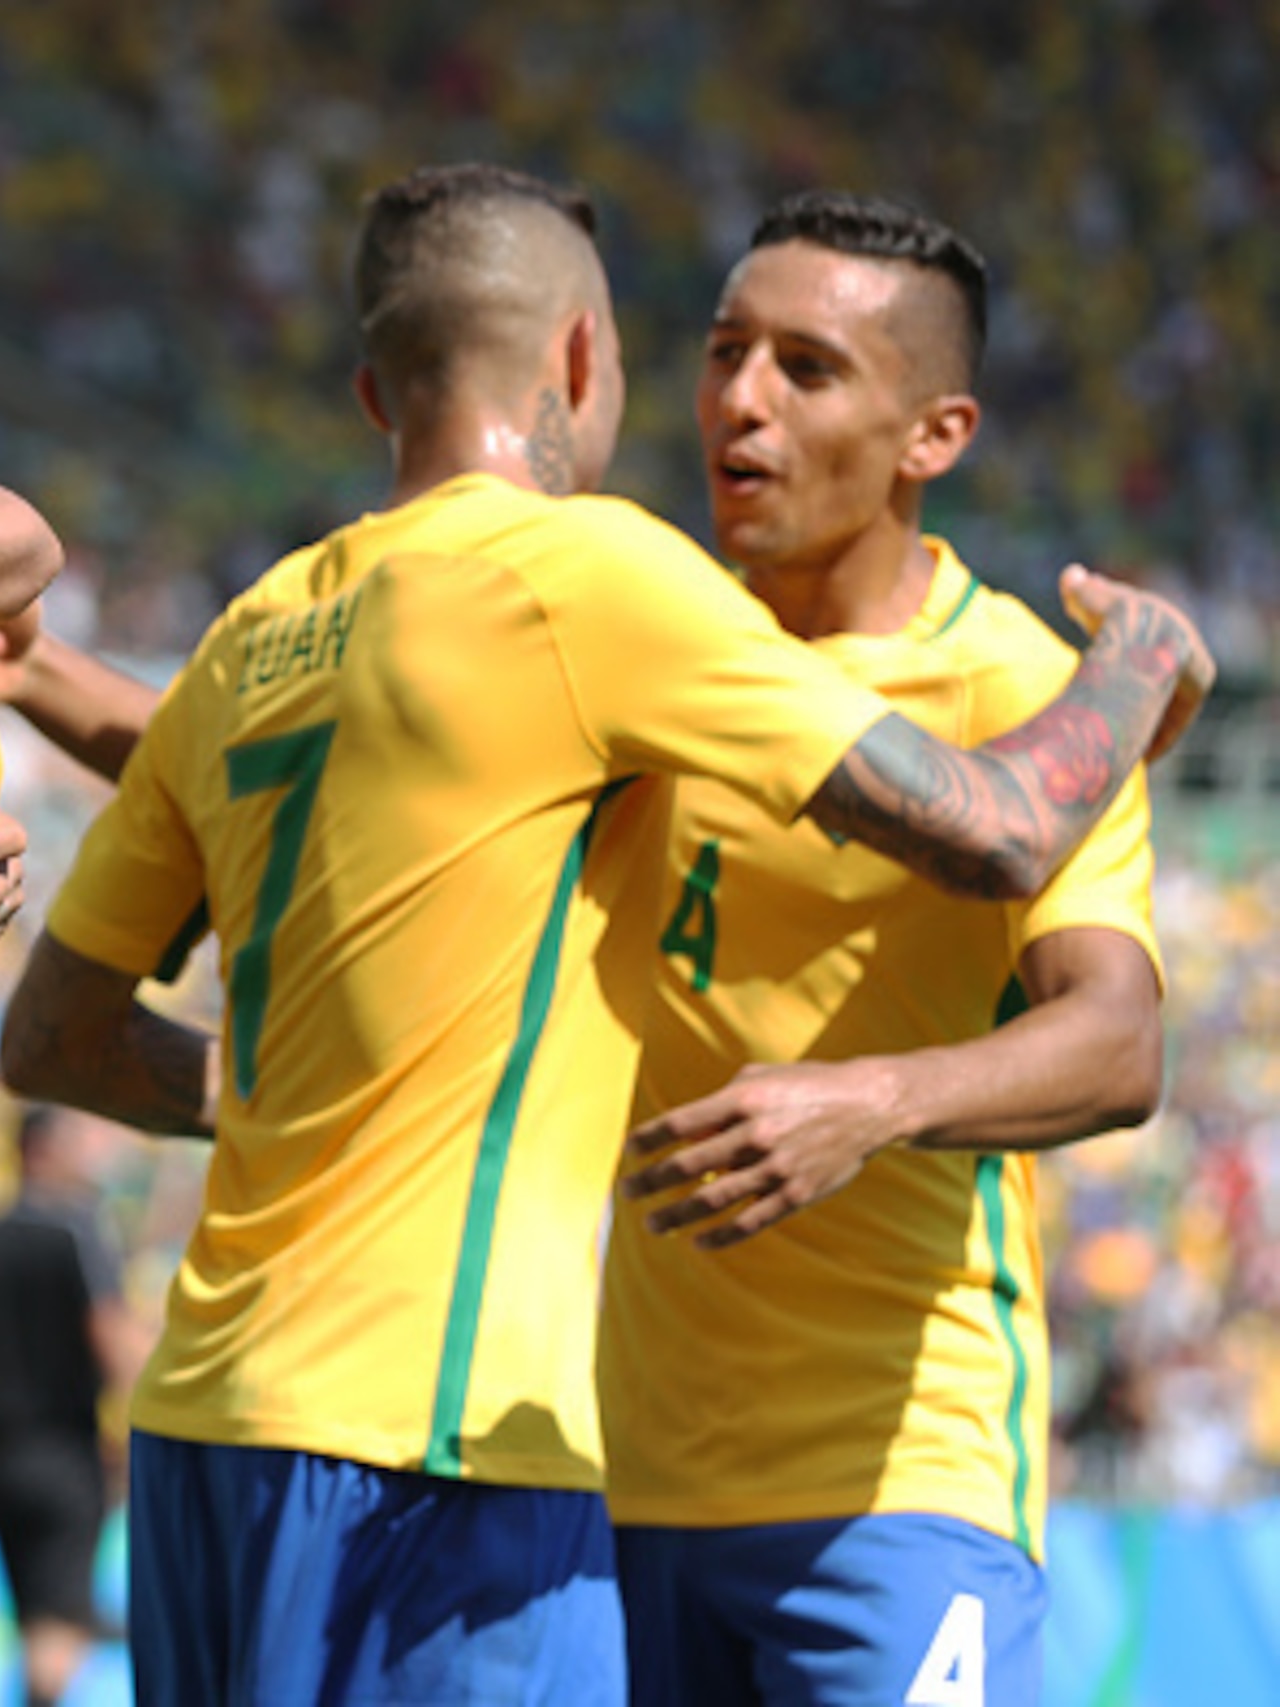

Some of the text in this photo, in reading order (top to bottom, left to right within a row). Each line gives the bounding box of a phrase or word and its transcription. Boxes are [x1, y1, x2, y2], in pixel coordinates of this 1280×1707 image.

[225, 719, 339, 1100] 7
[659, 838, 721, 993] 4
[903, 1592, 986, 1707] 4
